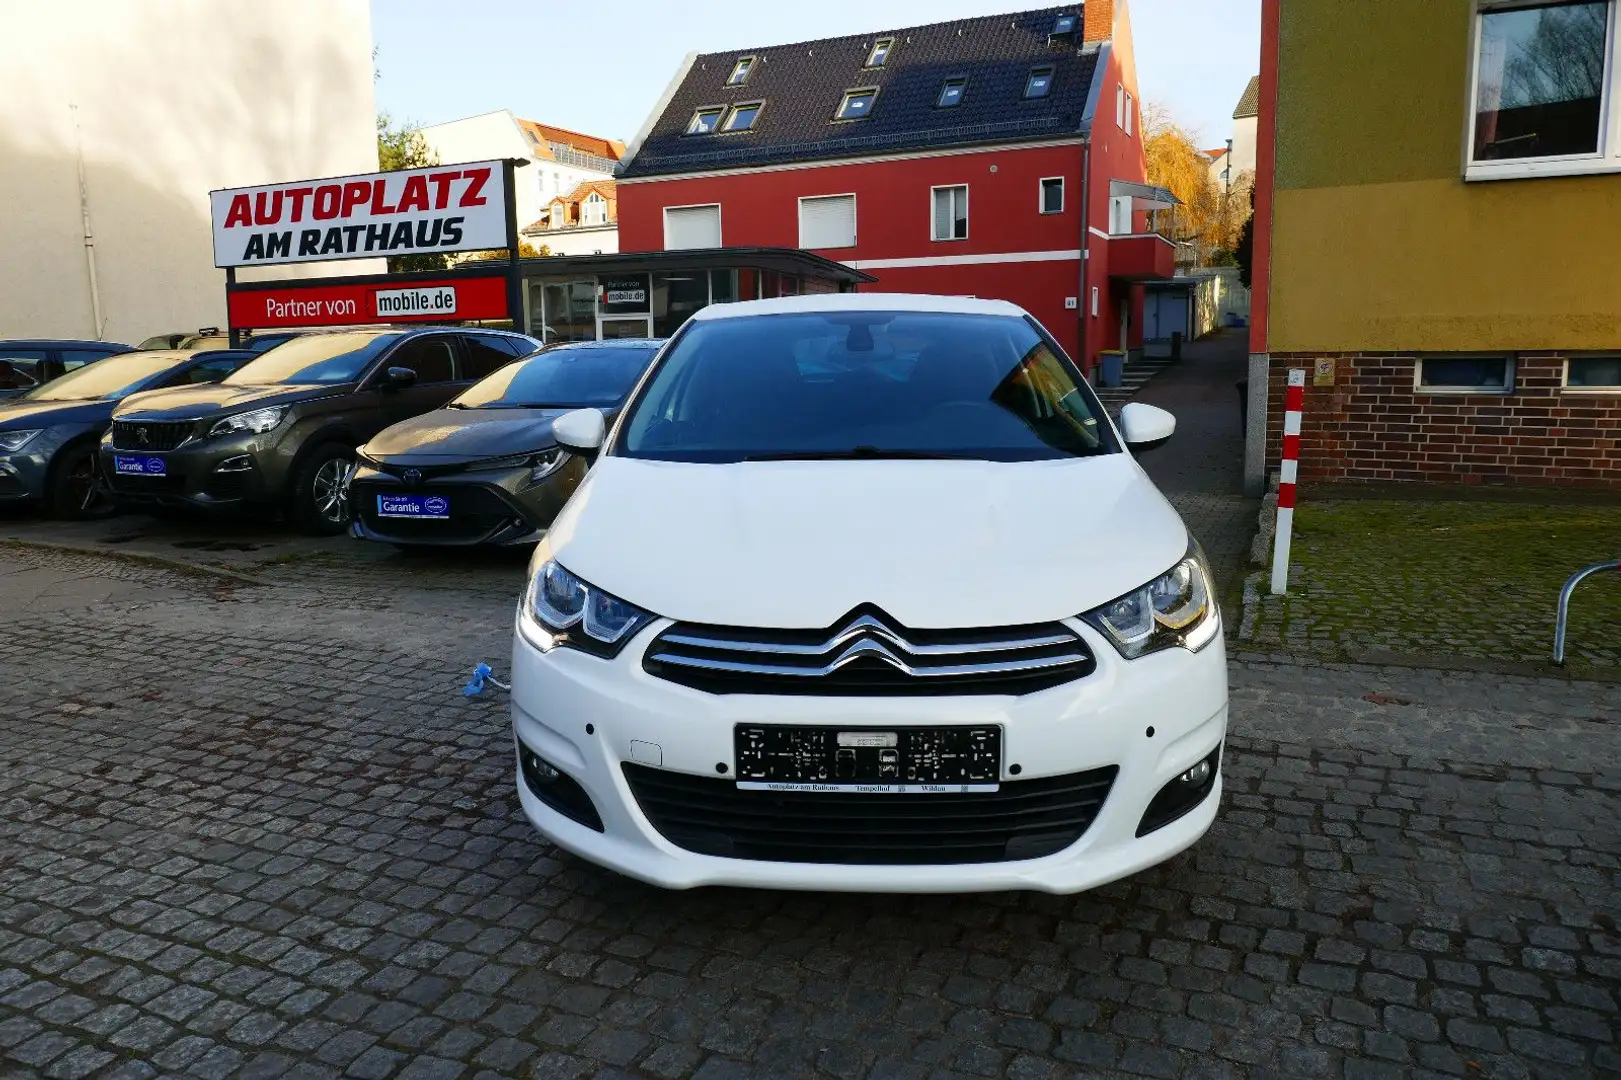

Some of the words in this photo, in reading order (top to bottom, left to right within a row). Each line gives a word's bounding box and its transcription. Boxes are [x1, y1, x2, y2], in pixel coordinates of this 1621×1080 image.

[224, 168, 491, 228] AUTOPLATZ
[243, 231, 291, 260] AM
[298, 217, 465, 257] RATHAUS
[266, 298, 323, 317] Partner
[327, 300, 356, 316] von
[379, 290, 453, 312] mobile.de
[608, 291, 644, 300] mobile.de
[383, 501, 420, 513] Garantie
